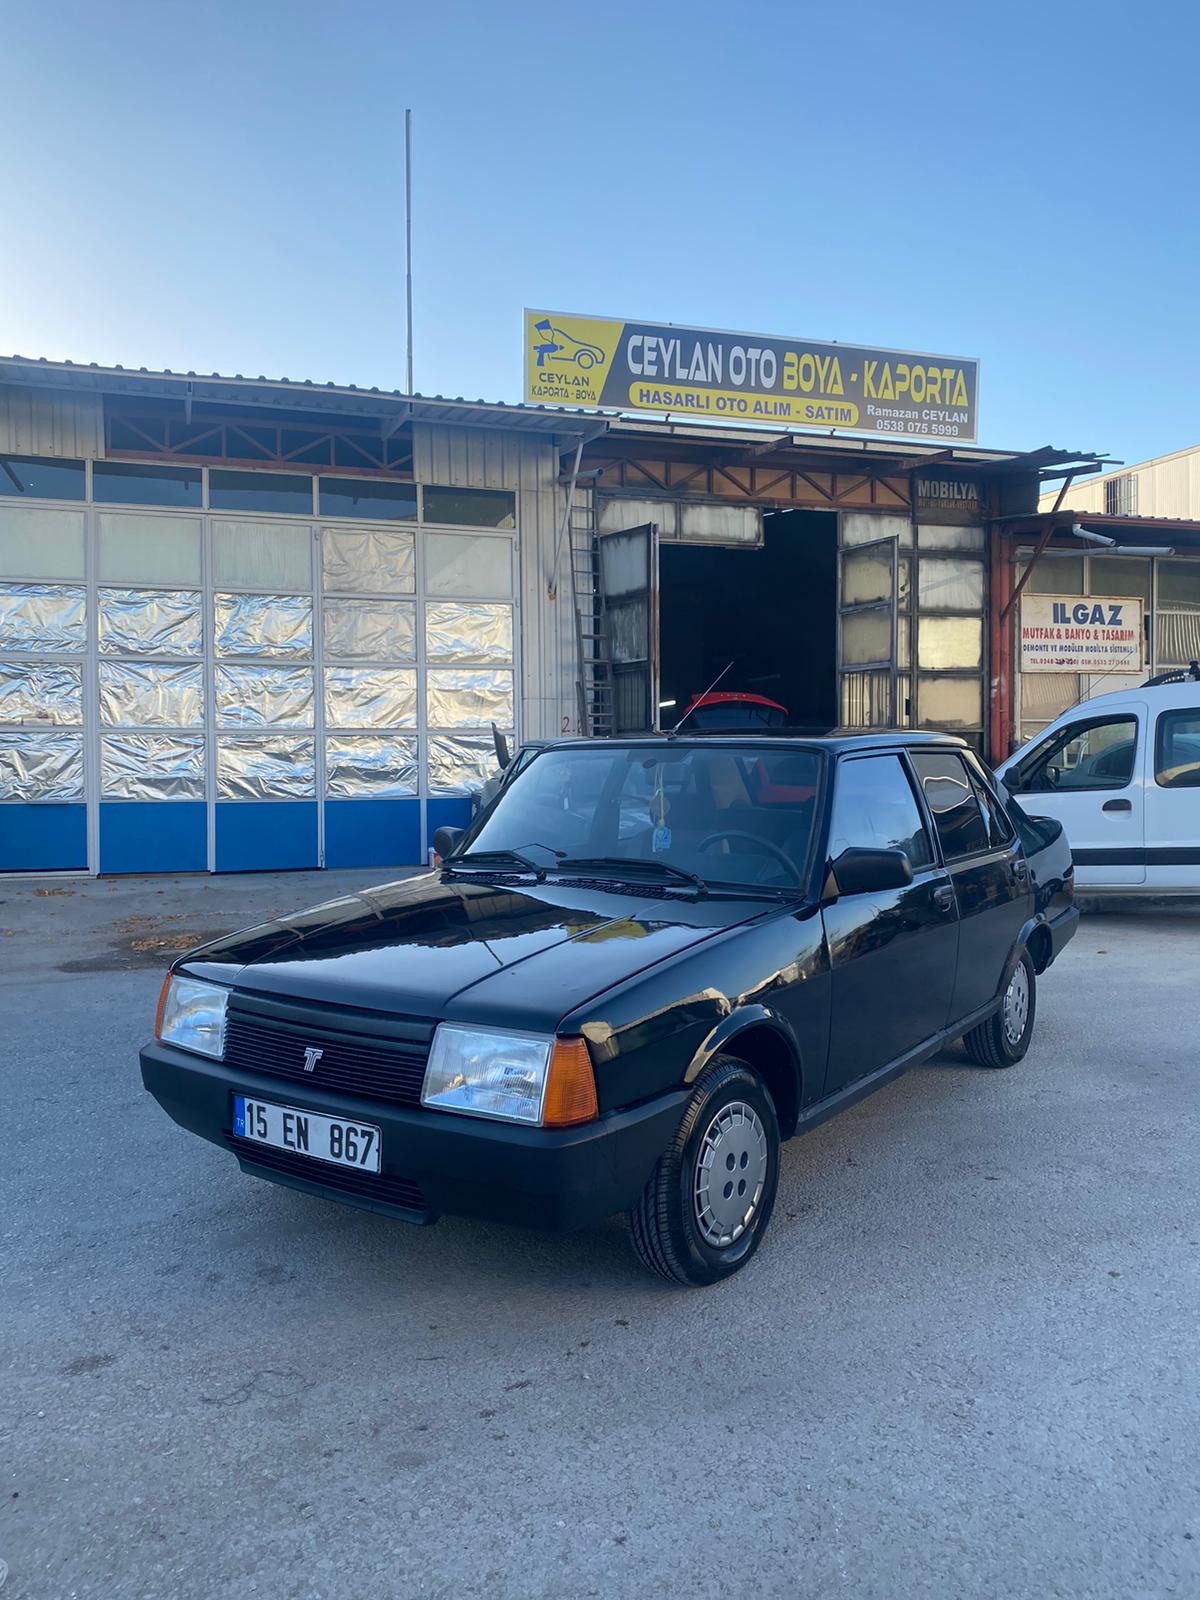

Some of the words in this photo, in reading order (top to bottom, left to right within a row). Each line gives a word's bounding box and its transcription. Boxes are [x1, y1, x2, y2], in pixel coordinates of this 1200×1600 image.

[538, 372, 590, 387] CEYLAN
[627, 334, 722, 384] CEYLAN
[729, 345, 777, 389] OTO
[783, 351, 844, 396] BOYA
[863, 360, 969, 407] KAPORTA
[531, 386, 569, 399] KAPORTA
[576, 389, 596, 401] BOYA
[639, 388, 710, 410] HASARLI
[715, 396, 748, 413] OTO
[752, 400, 791, 417] ALIM
[805, 405, 852, 422] SATIM
[867, 404, 919, 420] Ramazan
[922, 409, 968, 424] CEYLAN
[876, 419, 904, 432] 0538
[907, 421, 929, 434] 075
[931, 423, 959, 436] 5999
[1052, 602, 1123, 626] ILGAZ
[1022, 627, 1055, 640] MUTFAK
[1056, 628, 1062, 640] &
[1064, 628, 1091, 641] BANYO
[1093, 629, 1099, 641] &
[1101, 629, 1135, 642] TASARIM
[1023, 644, 1049, 652] DEMONTE
[1050, 644, 1058, 652] VE
[246, 1103, 268, 1139] 15
[282, 1112, 310, 1152] EN
[329, 1123, 375, 1166] 867
